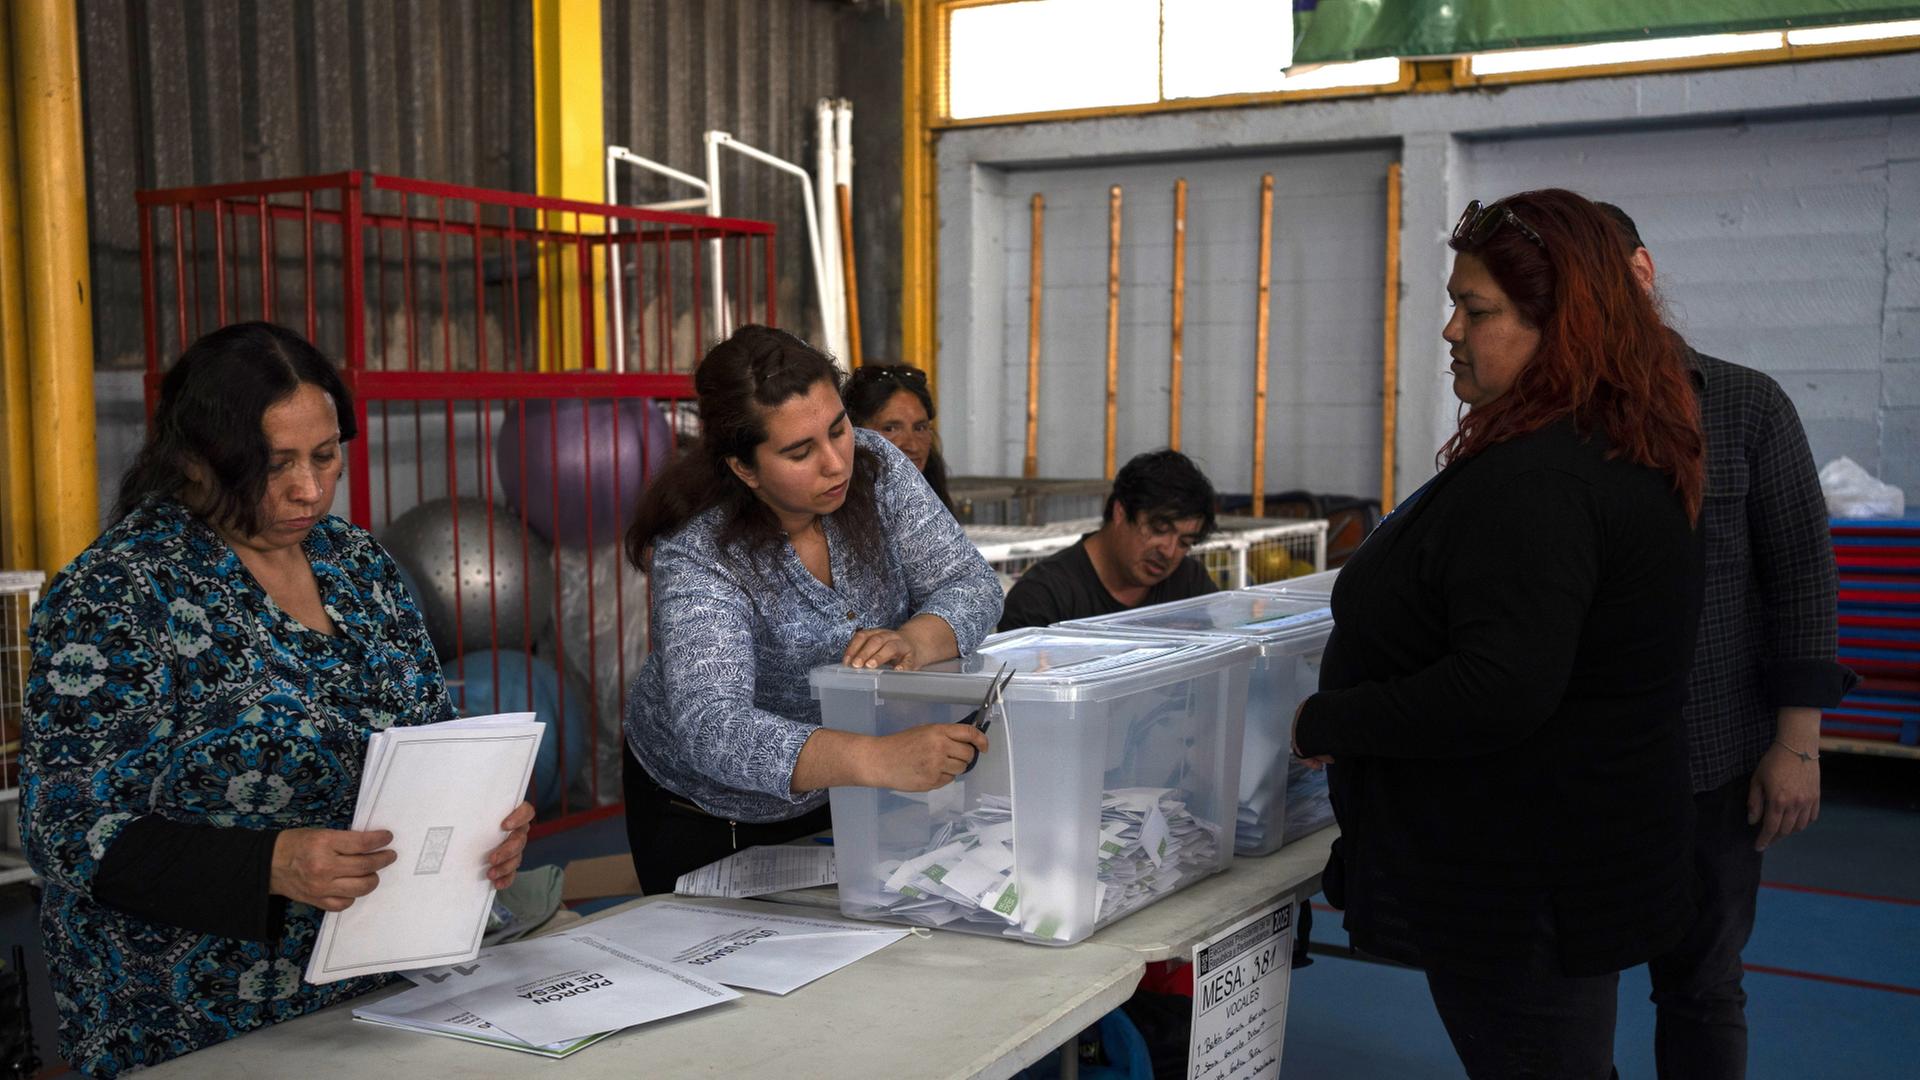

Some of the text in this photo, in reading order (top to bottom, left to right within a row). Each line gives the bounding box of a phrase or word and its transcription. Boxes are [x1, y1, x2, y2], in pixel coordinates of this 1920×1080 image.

[1274, 907, 1289, 931] 2025
[517, 980, 575, 999] MESA
[575, 973, 604, 984] DE
[1202, 964, 1246, 1011] MESA:
[1252, 945, 1277, 984] 381
[532, 979, 613, 1005] PADRÓN
[1225, 987, 1260, 1018] VOCALES
